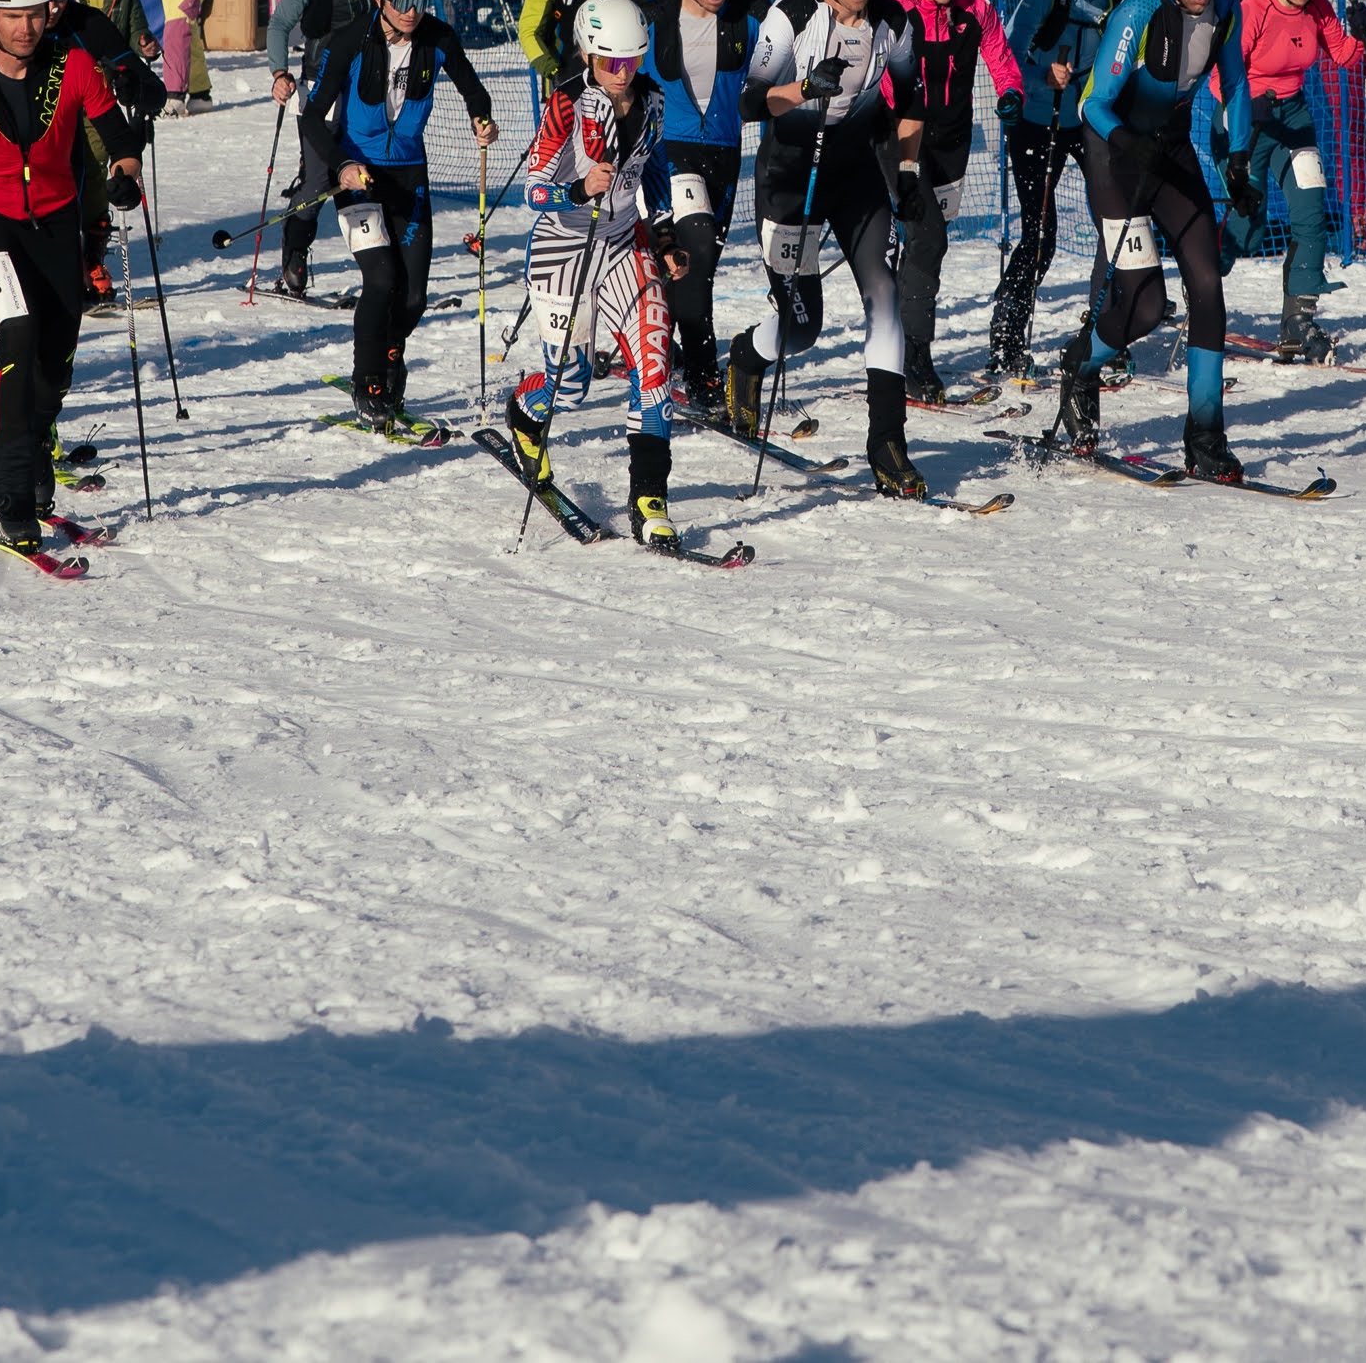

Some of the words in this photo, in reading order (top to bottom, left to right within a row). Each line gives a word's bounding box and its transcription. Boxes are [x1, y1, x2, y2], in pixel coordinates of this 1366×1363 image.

[685, 187, 695, 201] 4
[360, 219, 370, 234] 5
[780, 242, 800, 260] 35
[1126, 236, 1142, 253] 14
[549, 312, 570, 331] 32
